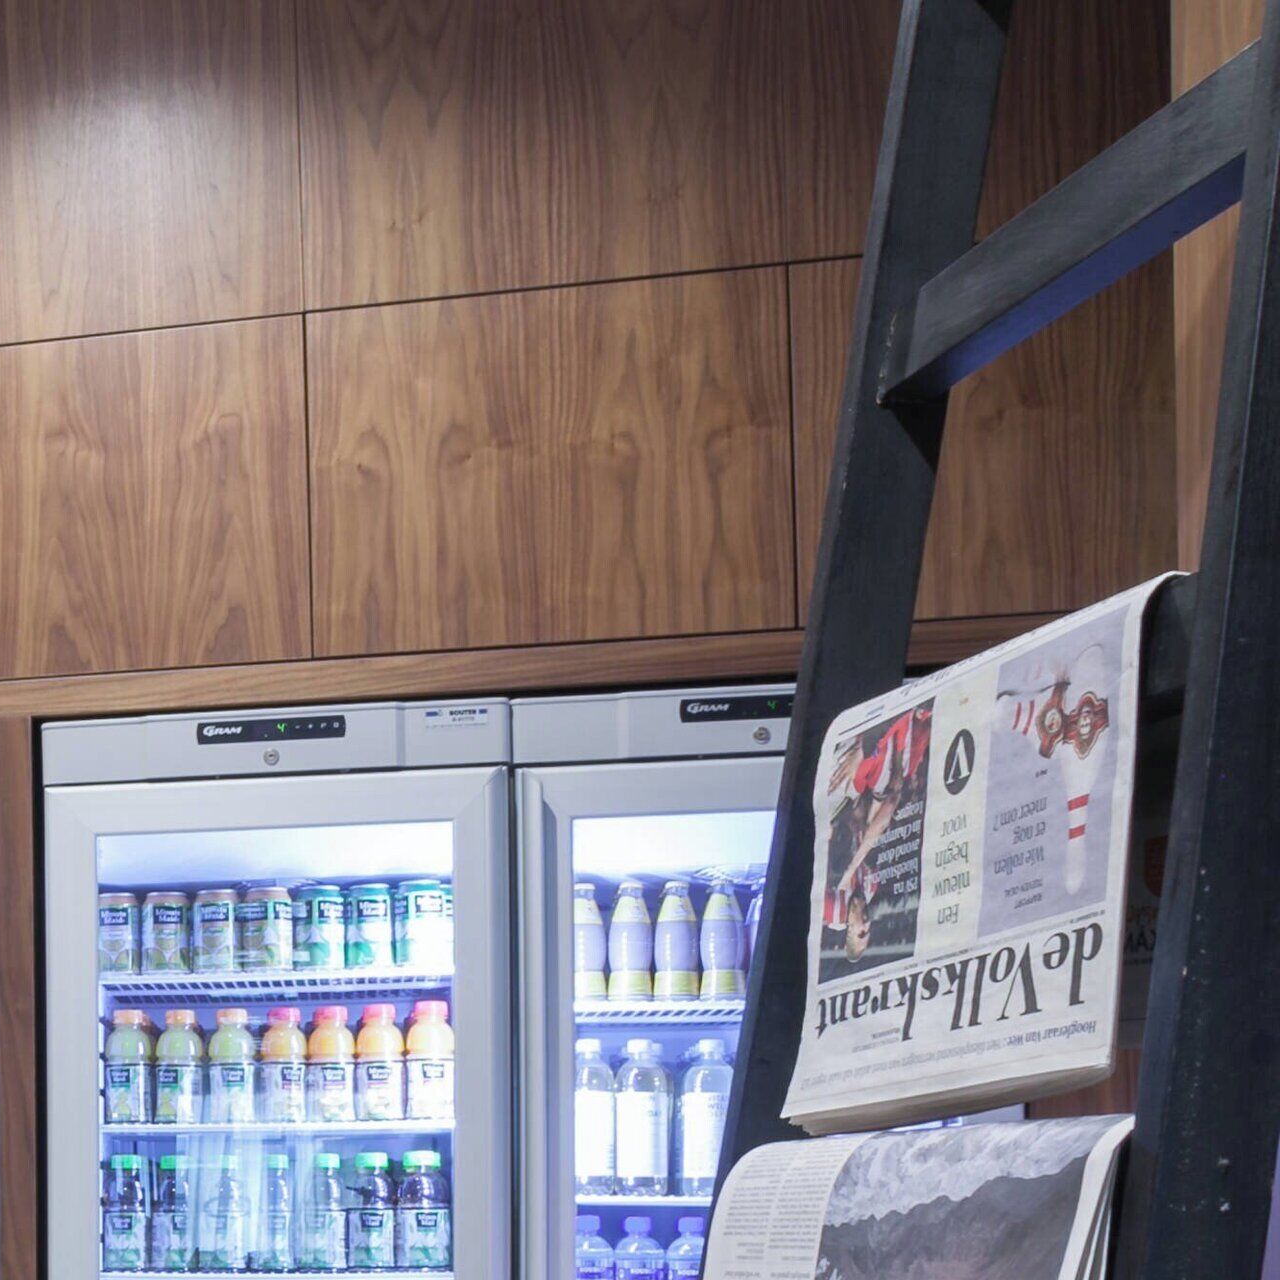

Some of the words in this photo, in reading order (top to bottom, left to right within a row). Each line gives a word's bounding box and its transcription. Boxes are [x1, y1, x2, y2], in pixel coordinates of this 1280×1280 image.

[687, 702, 730, 714] GRAM
[202, 725, 242, 736] GRAM
[940, 814, 968, 839] voor
[935, 840, 969, 869] begin
[932, 870, 971, 898] nieuw
[937, 903, 960, 925] Een
[1042, 922, 1103, 1006] de
[815, 942, 1042, 1042] Volkskrant
[1042, 1020, 1096, 1041] Hoogleraar
